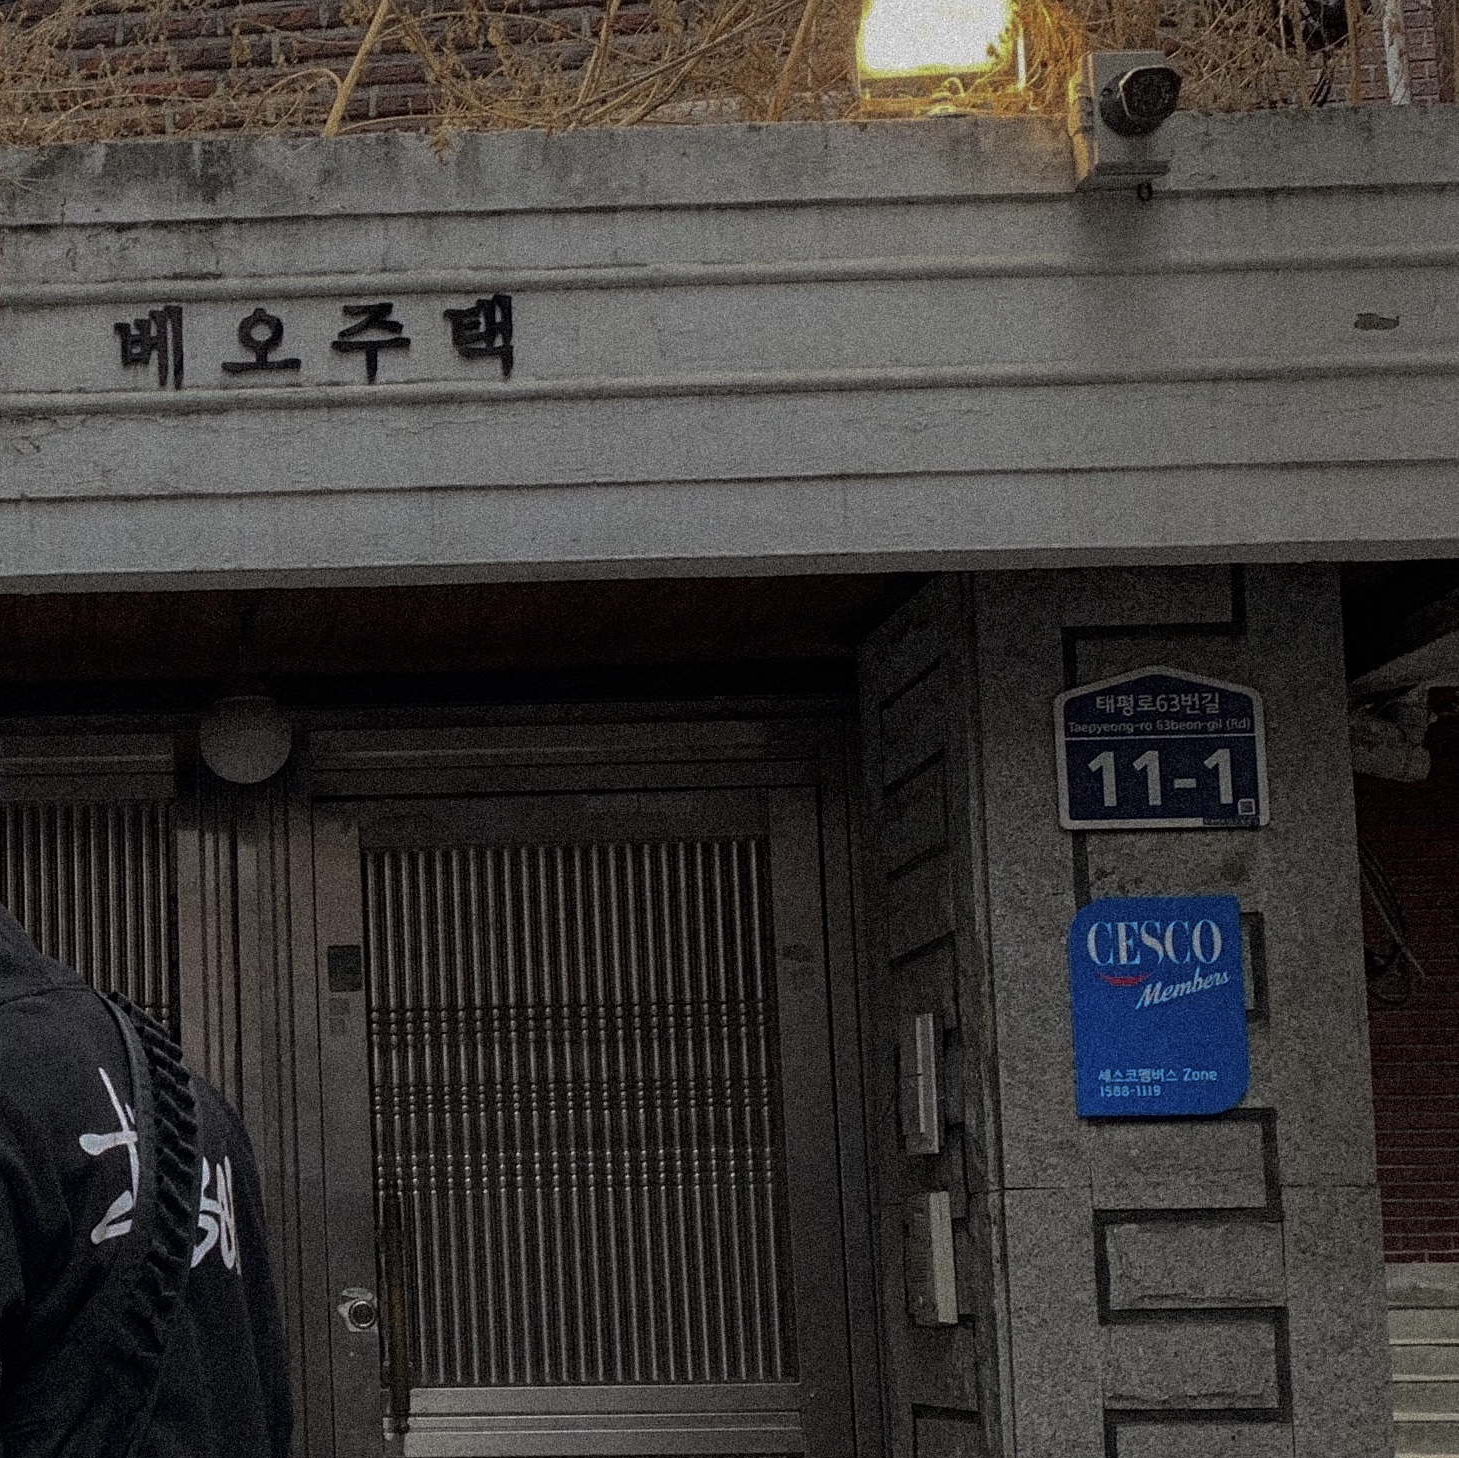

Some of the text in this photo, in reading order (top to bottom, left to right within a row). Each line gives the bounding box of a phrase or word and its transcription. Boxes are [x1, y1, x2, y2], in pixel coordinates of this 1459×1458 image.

[1095, 692, 1220, 716] 태평로63번길
[1068, 720, 1153, 734] Taepyeong-ro
[1156, 718, 1223, 732] 63beon-gil
[1087, 748, 1234, 807] 11-1
[1087, 919, 1223, 966] CESCO
[1135, 966, 1231, 1010] Members
[1182, 1067, 1218, 1082] Zone
[1100, 1084, 1162, 1098] 1588-1119
